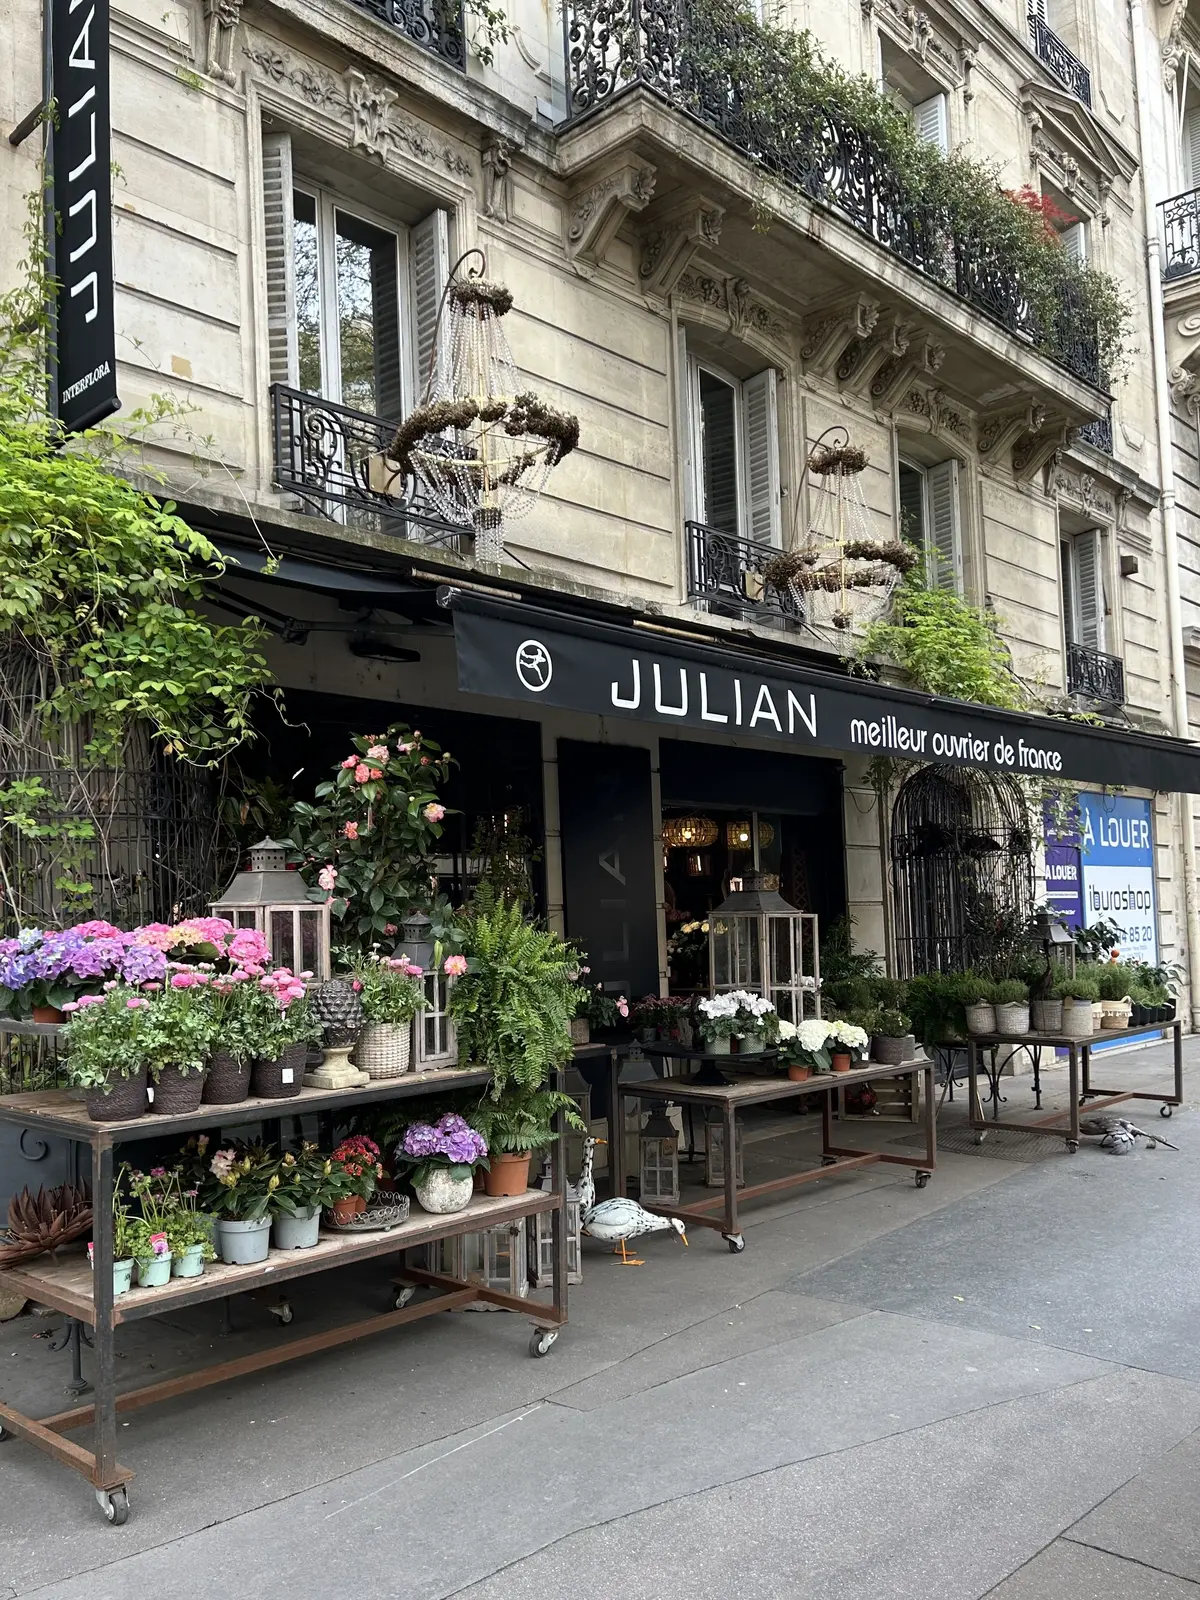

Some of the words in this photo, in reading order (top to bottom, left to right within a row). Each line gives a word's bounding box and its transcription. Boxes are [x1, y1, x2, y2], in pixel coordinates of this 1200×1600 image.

[68, 0, 98, 324] JULIA
[62, 361, 111, 404] INTERFLORA
[611, 659, 817, 738] JULIAN
[850, 715, 928, 753] meilleur
[932, 732, 990, 762] ouvrier
[993, 735, 1015, 766] de
[1018, 738, 1063, 772] france
[1083, 807, 1095, 846] À
[1100, 816, 1150, 849] LOUER
[1052, 864, 1077, 881] LOUER
[1089, 884, 1151, 915] iburoshop
[1129, 926, 1140, 942] 85
[1142, 925, 1153, 942] 20
